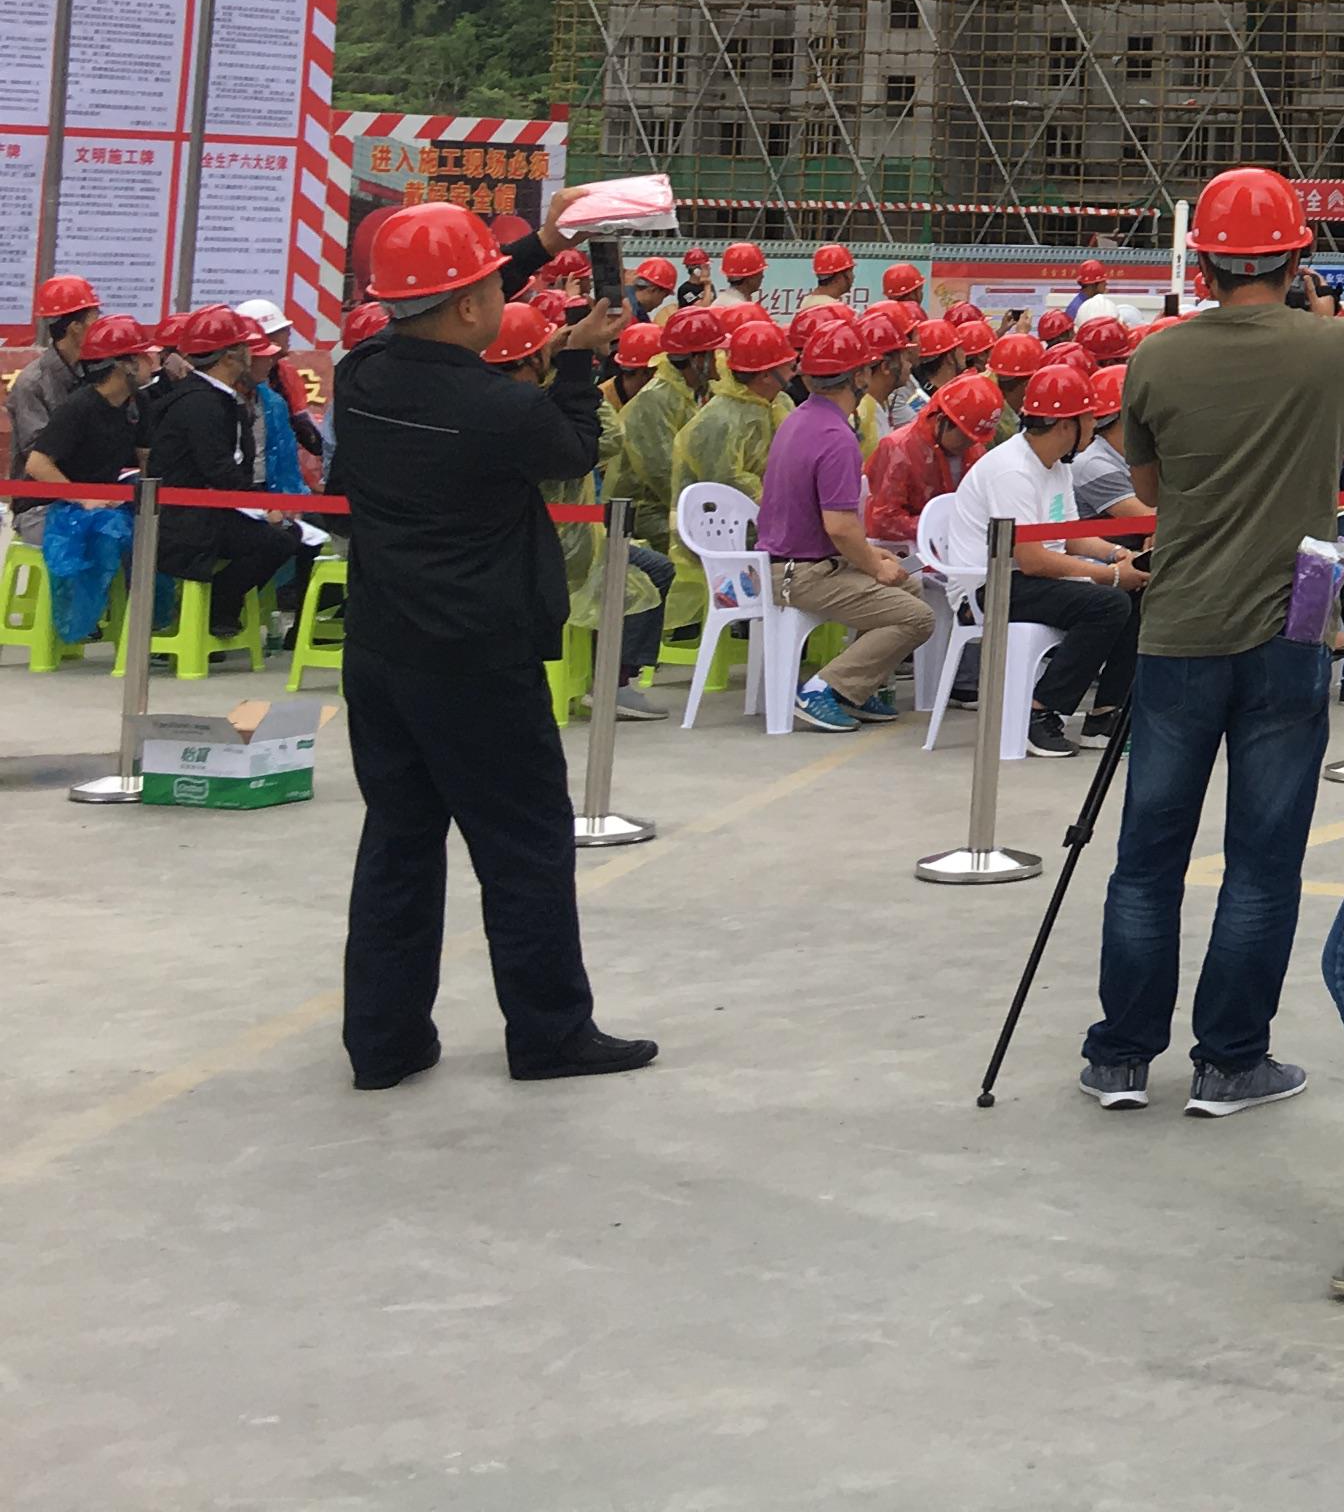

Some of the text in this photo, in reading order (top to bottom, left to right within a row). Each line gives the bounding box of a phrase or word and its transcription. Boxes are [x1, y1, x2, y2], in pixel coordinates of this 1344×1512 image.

[74, 147, 156, 166] 文明施工牌
[201, 151, 289, 172] 全生产六大纪律
[369, 144, 551, 181] 进入施工现场必须
